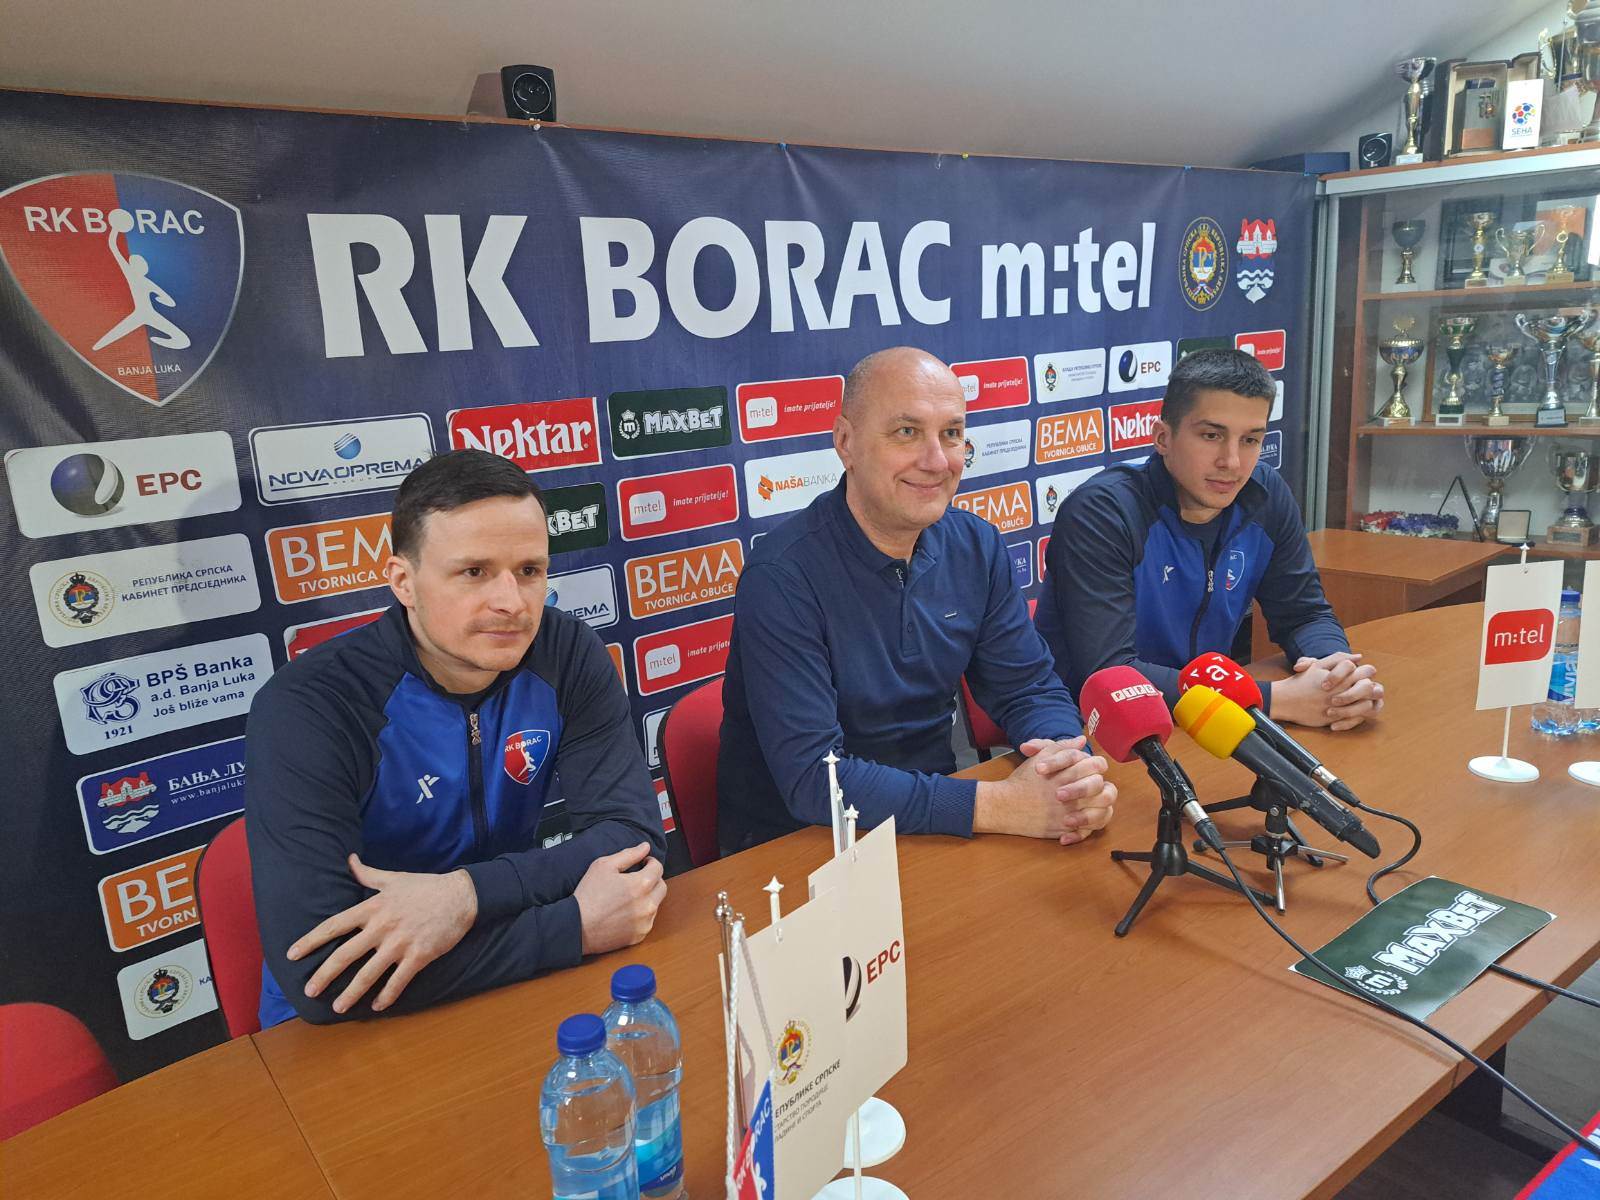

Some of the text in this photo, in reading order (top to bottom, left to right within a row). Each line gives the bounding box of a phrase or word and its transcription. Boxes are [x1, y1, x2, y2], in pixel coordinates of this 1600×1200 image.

[24, 206, 79, 233] RK
[307, 213, 1156, 358] RK BORAC m:tel
[117, 363, 182, 376] BANJA LUKA
[1140, 361, 1161, 374] EPC
[644, 405, 723, 435] MAXBET
[750, 400, 837, 419] m:tel imate prijatelje!
[457, 418, 591, 458] Nektar
[1040, 416, 1100, 449] BEMA
[1044, 446, 1076, 459] TVORNICA
[136, 469, 203, 497] EPC
[268, 458, 424, 487] NOVAOPREMA
[633, 490, 729, 516] m:tel imate prijatelje!
[281, 522, 393, 578] BEM
[132, 564, 233, 588] РЕПУБЛИКА СРПСКА
[298, 571, 379, 594] TVORNICA
[634, 549, 739, 598] BEMA
[121, 587, 171, 602] КАБИНЕТ
[645, 582, 734, 611] TVORNICA OBUĆE
[1494, 624, 1545, 647] m:tel
[146, 656, 253, 687] BPŠ Banka
[650, 654, 676, 670] m:tel
[687, 646, 708, 657] imate
[150, 672, 255, 702] a.d. Banja Luka
[153, 690, 245, 718] Još bliže vama
[104, 725, 133, 740] 1921
[168, 761, 246, 791] БАЊА ЛУ
[117, 863, 193, 924] BE
[136, 907, 198, 937] TVORN
[1372, 890, 1506, 976] MAXBET
[867, 940, 901, 985] EPC
[775, 1059, 841, 1118] ЕПУБЛИКЕ СРПСКЕ
